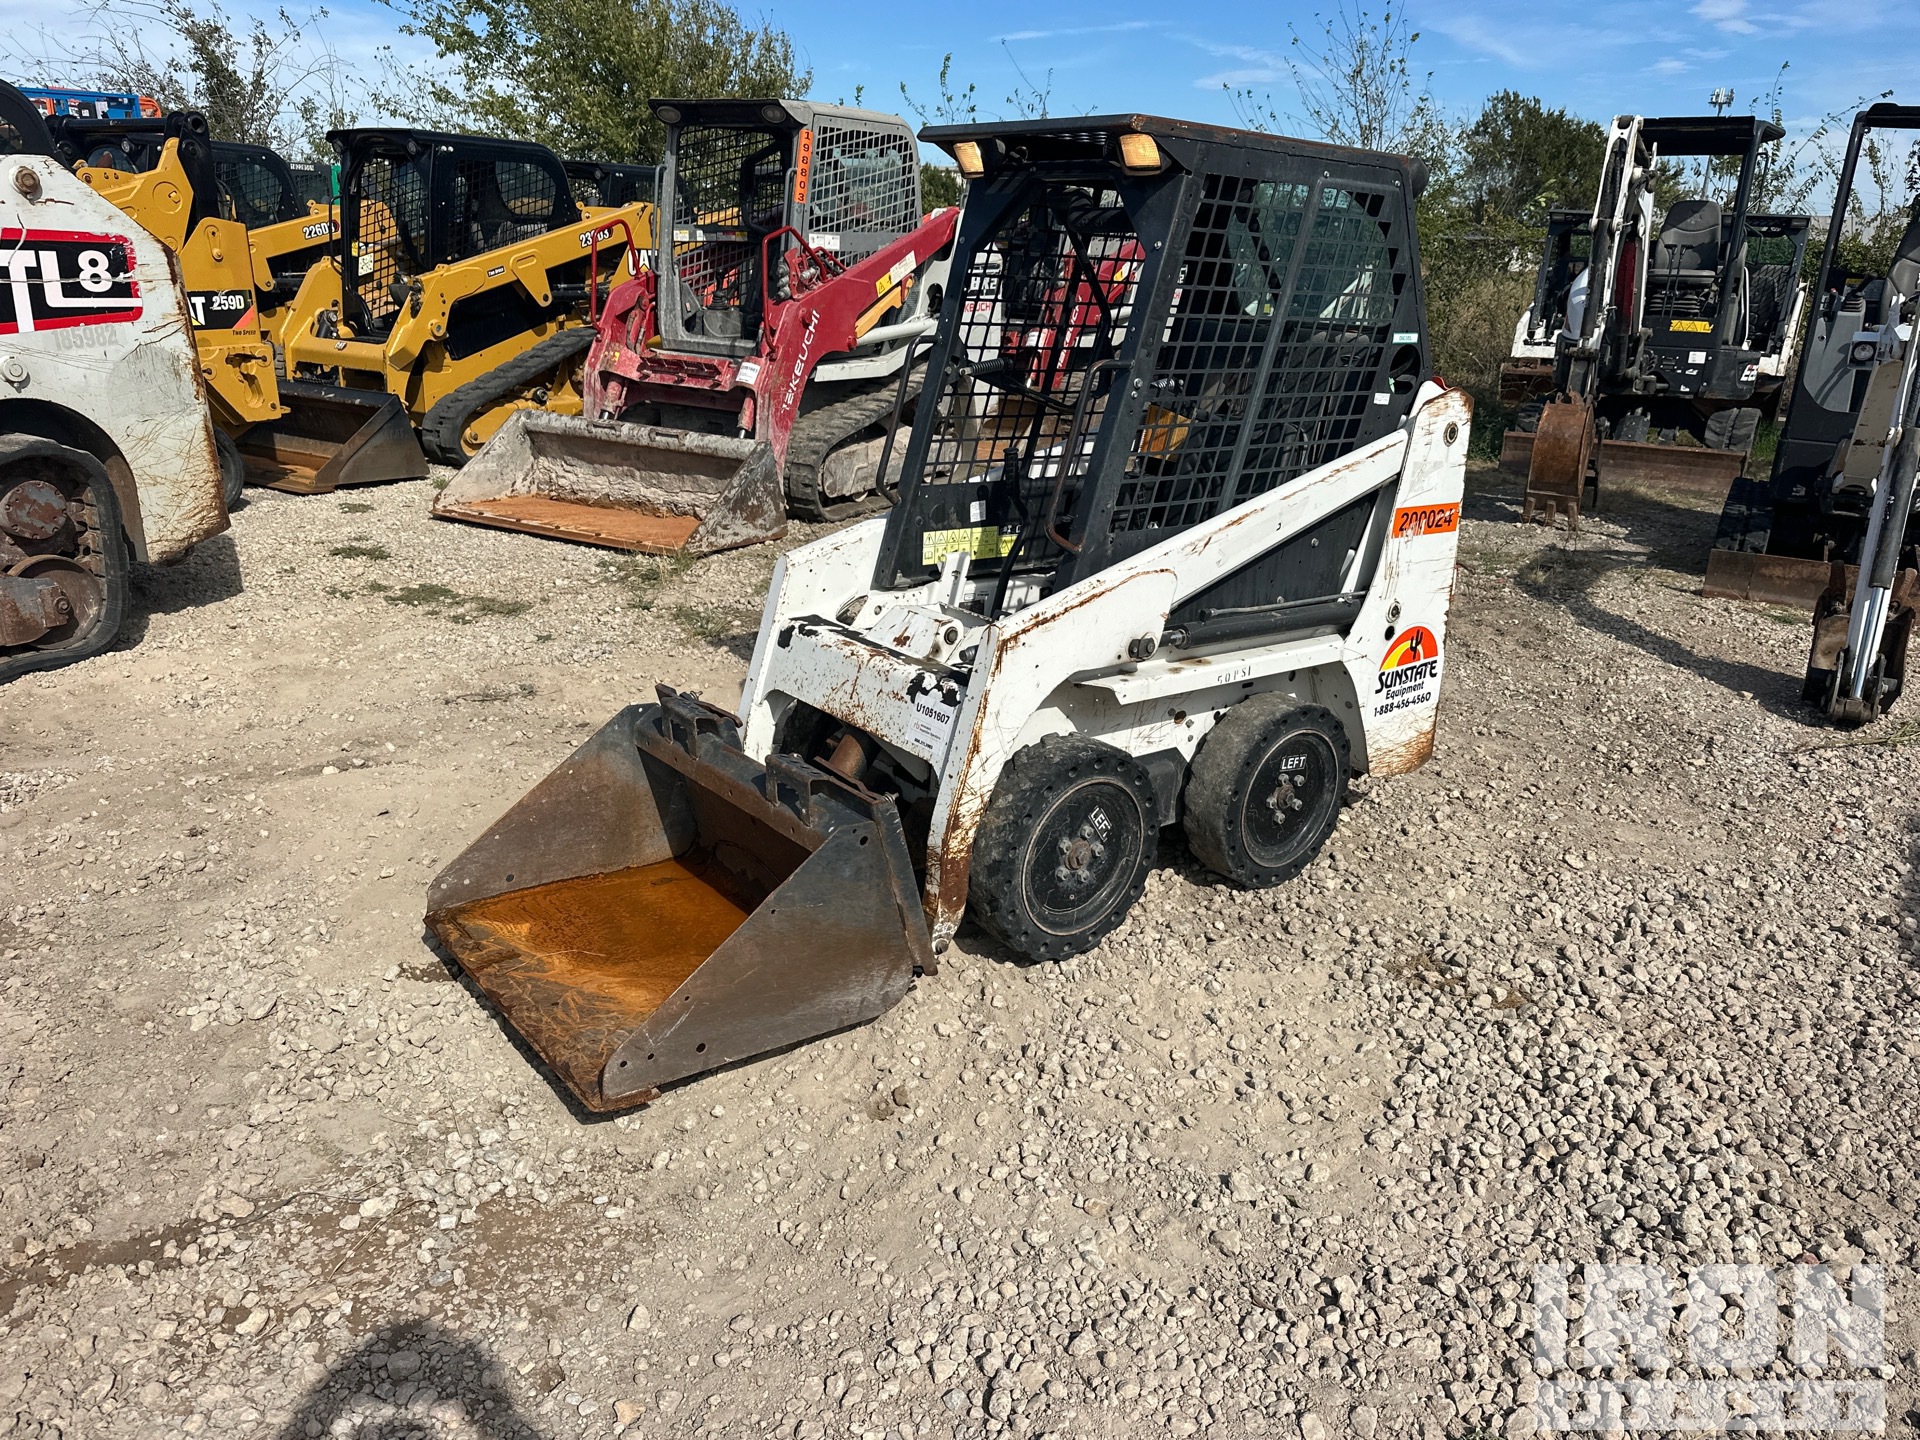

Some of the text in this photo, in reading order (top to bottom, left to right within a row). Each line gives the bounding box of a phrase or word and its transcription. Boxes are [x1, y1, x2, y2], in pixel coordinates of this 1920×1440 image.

[797, 131, 812, 202] 198803
[579, 228, 611, 248] 23D3
[627, 249, 658, 276] CA
[211, 294, 245, 311] 259D
[51, 326, 118, 351] 185982
[1398, 508, 1454, 533] 200024
[1374, 659, 1438, 695] SUNSTATE
[1385, 680, 1424, 700] Equipment
[916, 702, 951, 725] U1051607
[1373, 691, 1432, 718] 1-888-456-4560
[1281, 756, 1306, 770] LEFT
